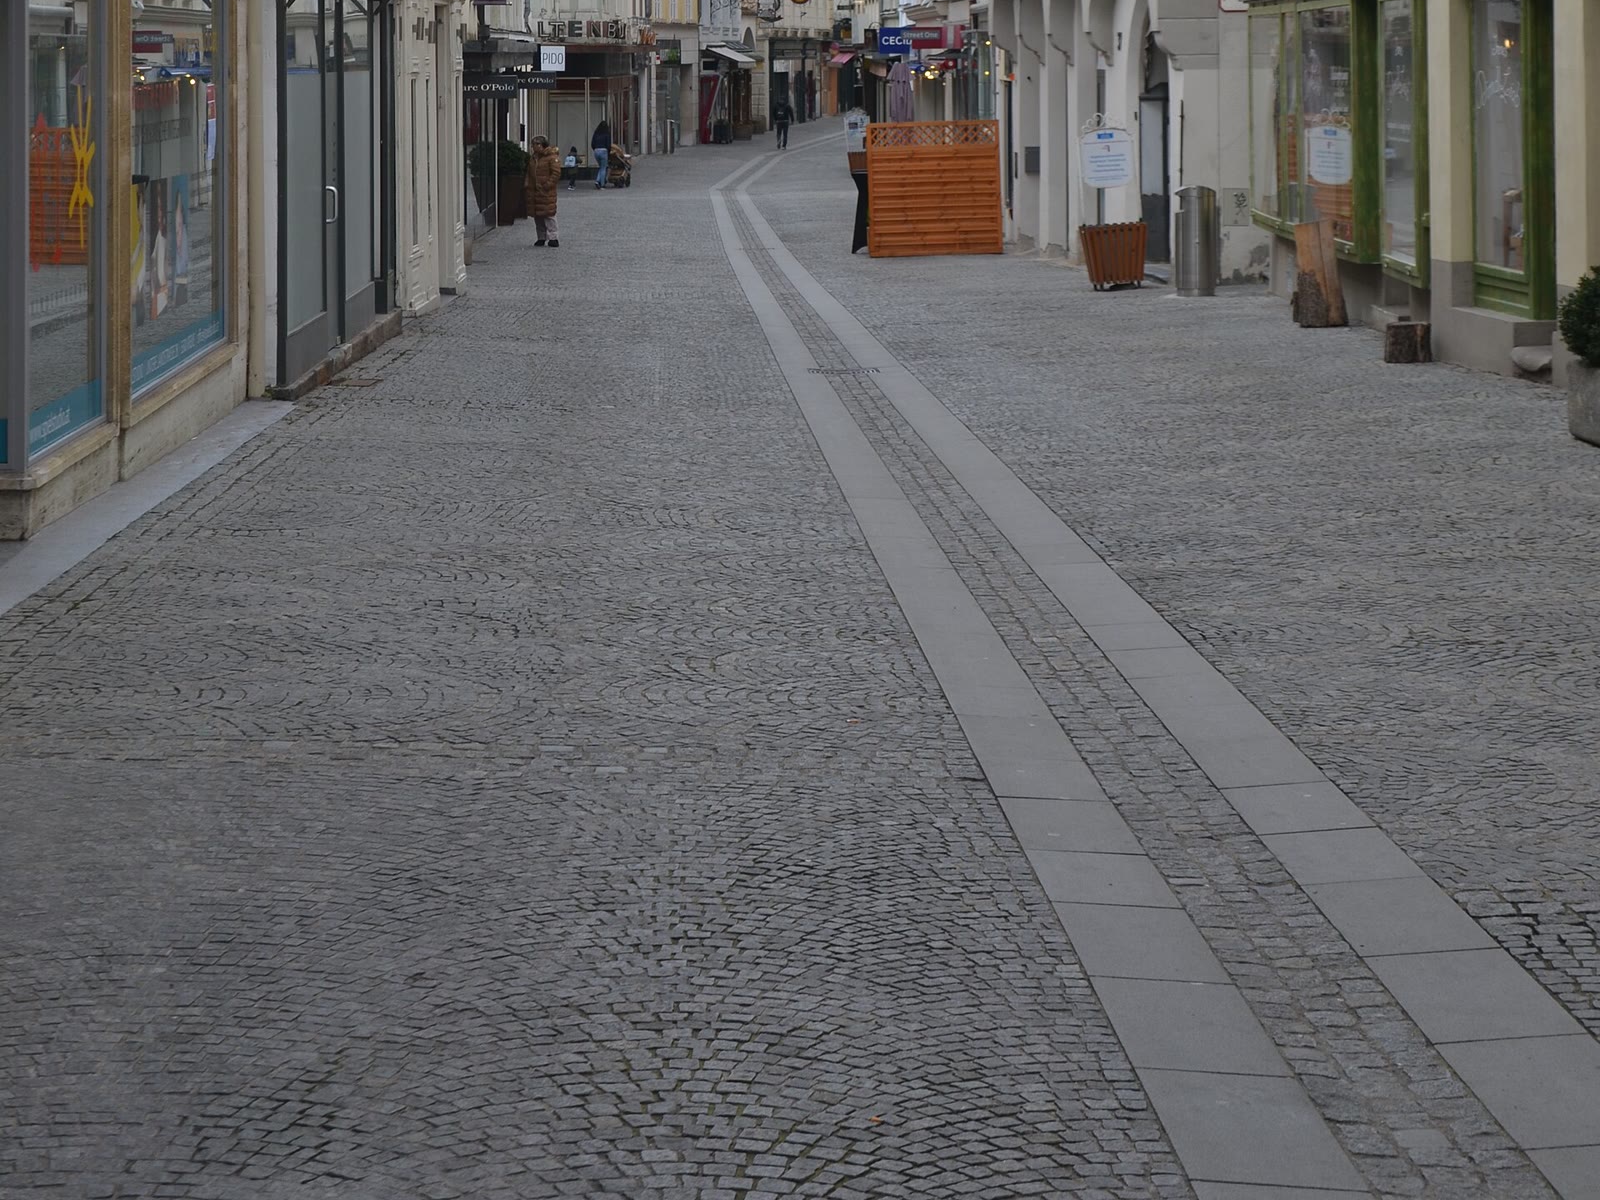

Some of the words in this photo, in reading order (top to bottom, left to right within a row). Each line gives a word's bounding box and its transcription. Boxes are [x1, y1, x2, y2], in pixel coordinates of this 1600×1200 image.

[903, 31, 924, 39] Street
[924, 31, 939, 39] One
[541, 51, 564, 66] PIDO
[480, 82, 515, 92] O'Polo
